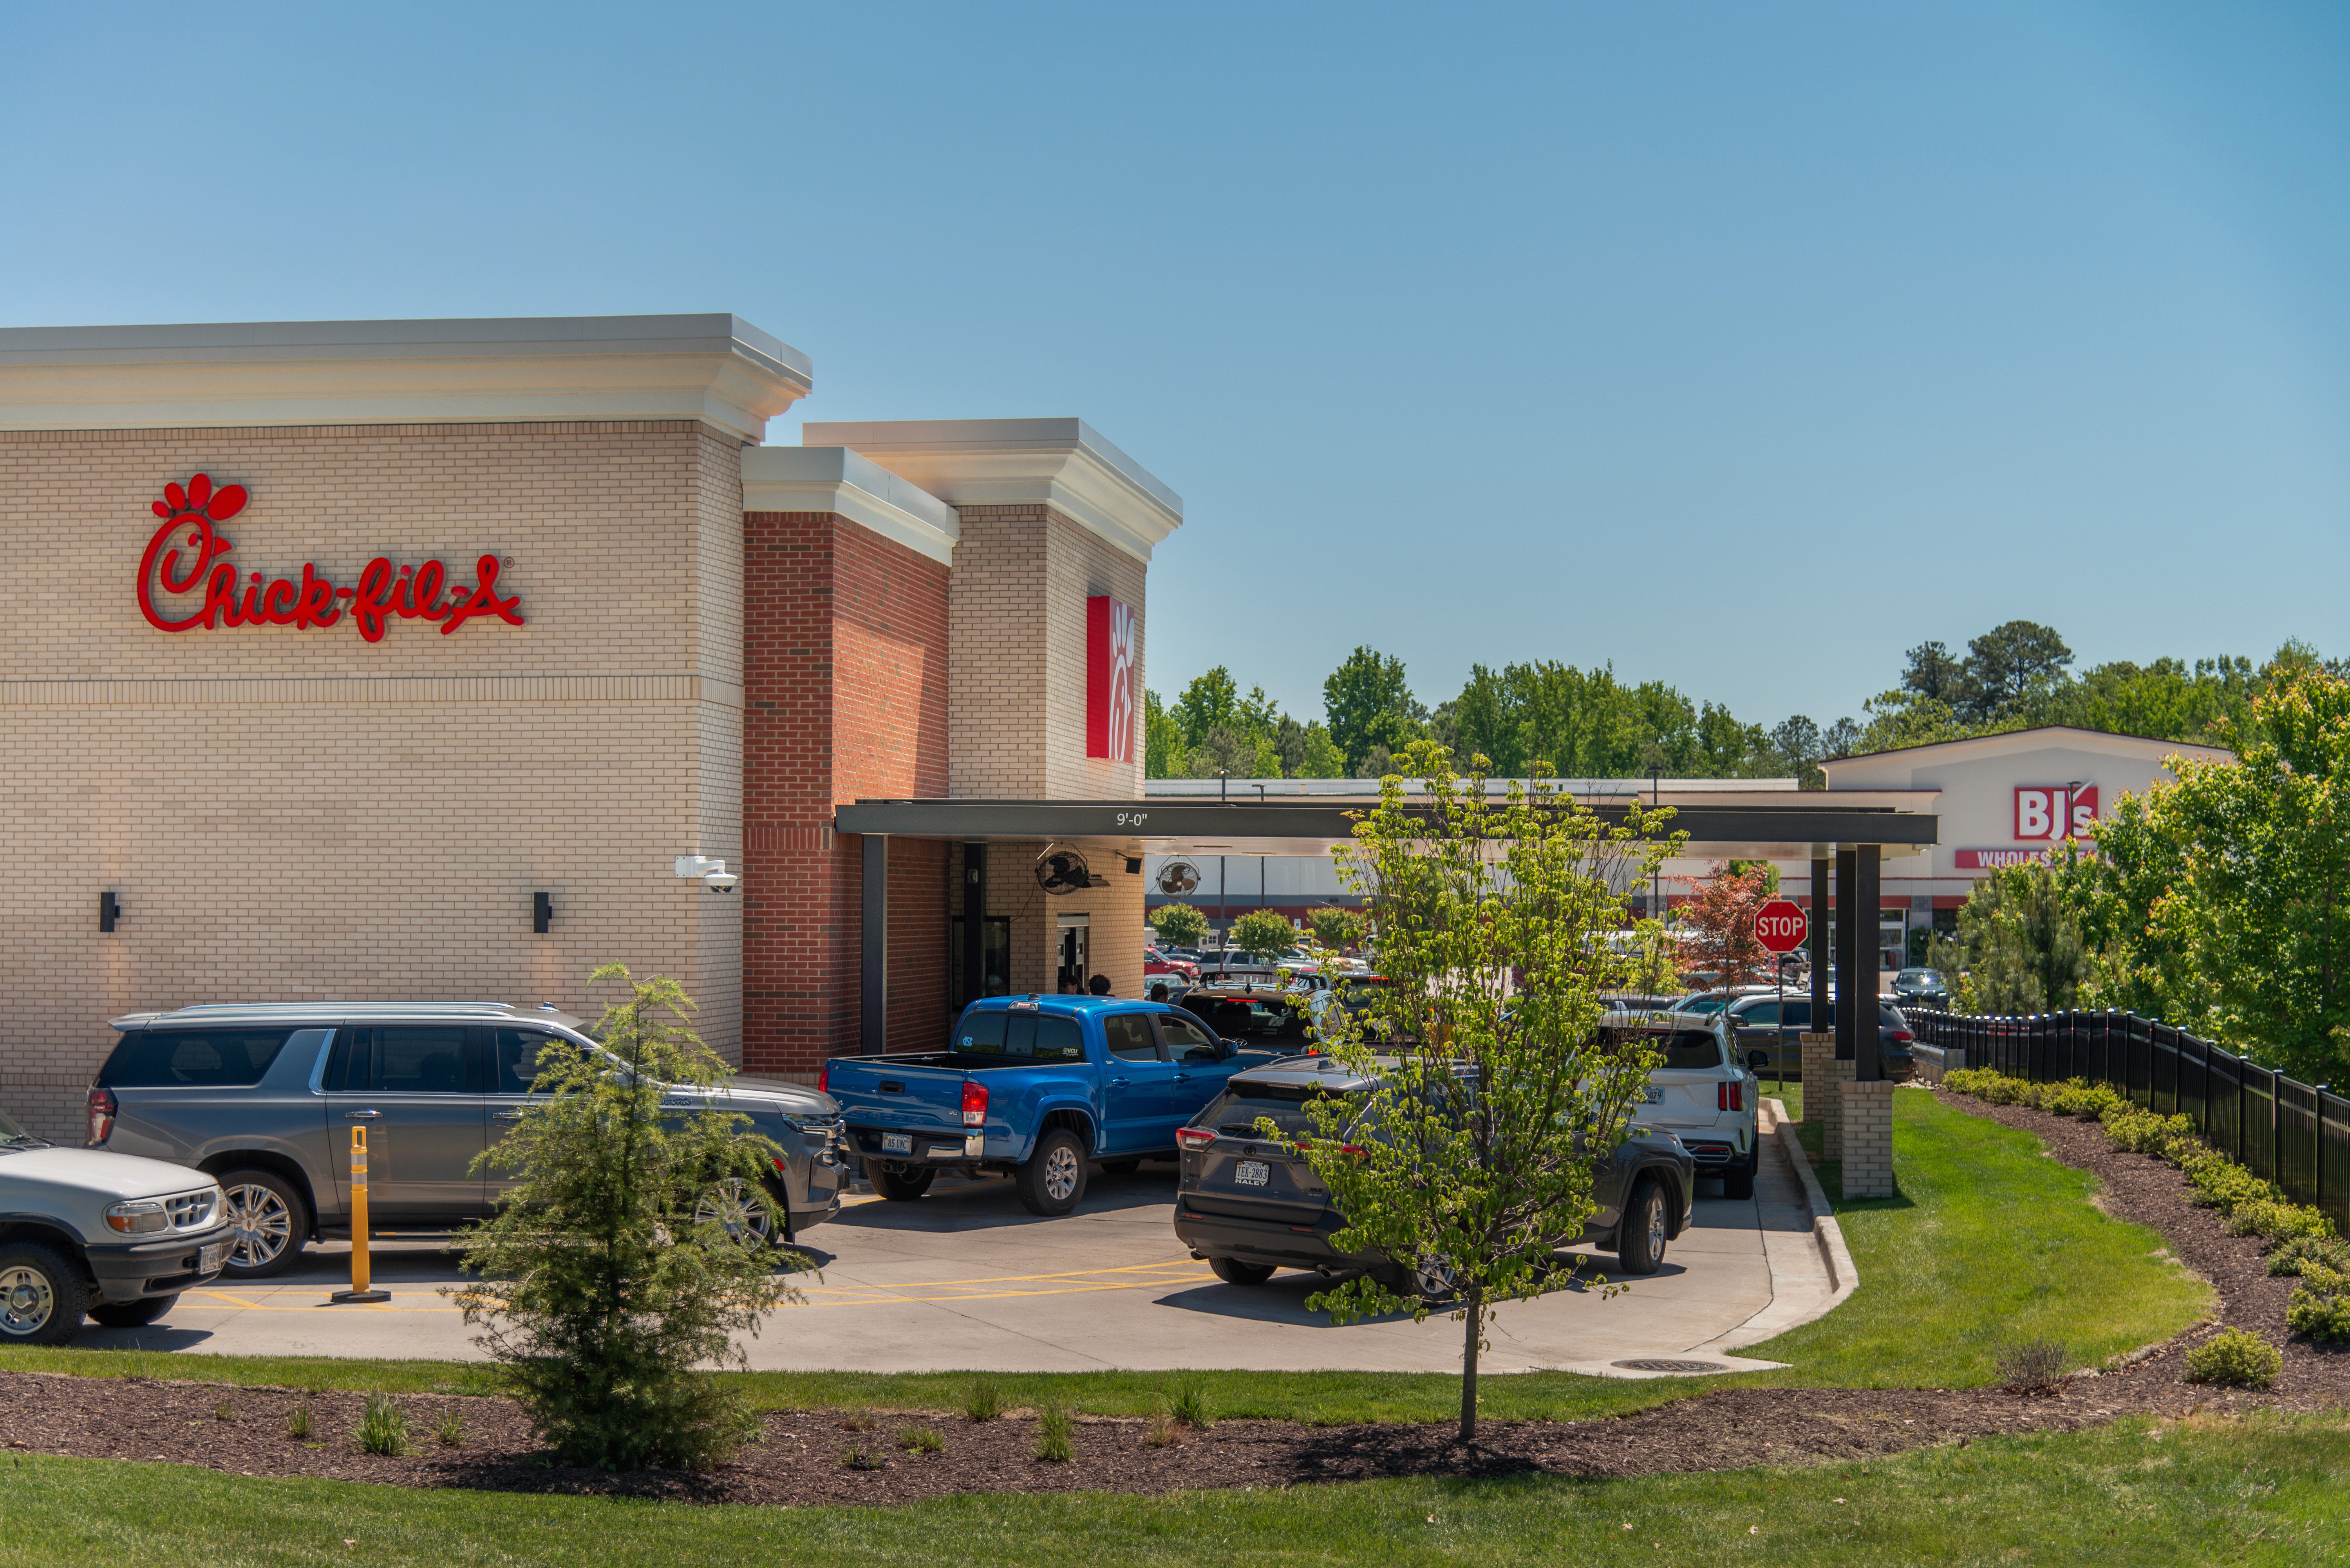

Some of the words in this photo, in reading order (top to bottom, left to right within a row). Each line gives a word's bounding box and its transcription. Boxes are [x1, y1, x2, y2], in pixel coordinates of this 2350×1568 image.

[137, 473, 525, 643] Chick-fil-A
[1117, 813, 1147, 826] 9'-0"
[1758, 917, 1803, 936] STOP
[888, 1138, 895, 1147] 85
[897, 1139, 906, 1149] UNC
[1238, 1166, 1267, 1179] TEK-2883
